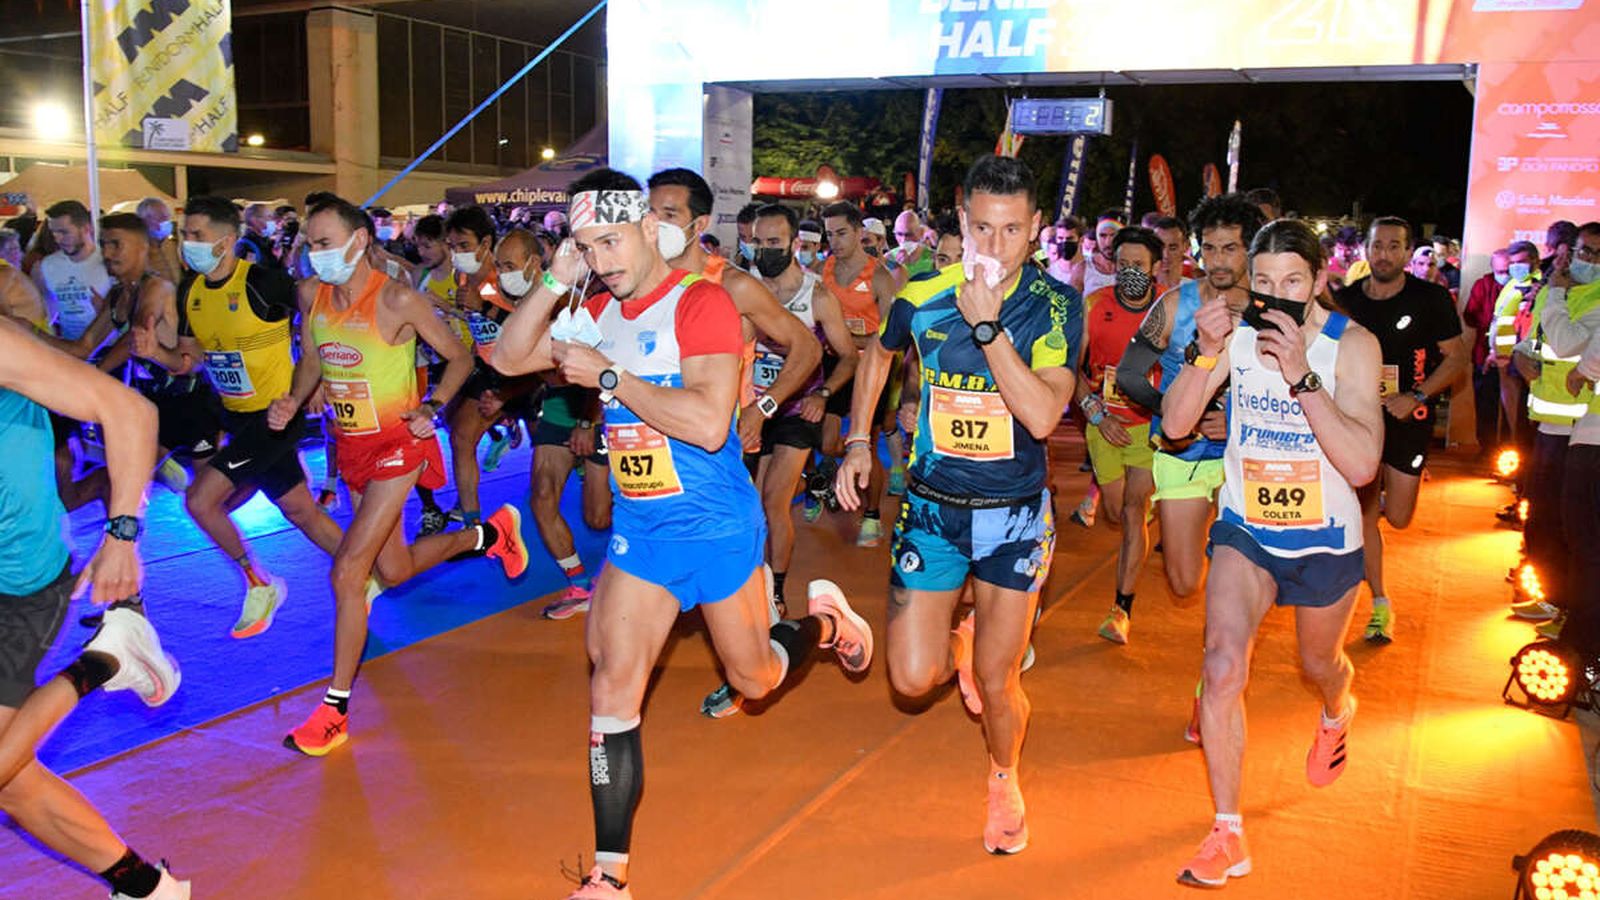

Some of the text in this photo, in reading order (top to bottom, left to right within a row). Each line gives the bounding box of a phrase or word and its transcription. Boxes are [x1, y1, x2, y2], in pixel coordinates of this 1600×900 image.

[932, 18, 1056, 60] HALF
[333, 402, 355, 418] 119
[951, 419, 988, 439] 817
[952, 441, 990, 452] JIMENA
[620, 455, 653, 476] 437
[1257, 487, 1306, 507] 849
[1263, 510, 1302, 519] COLETA
